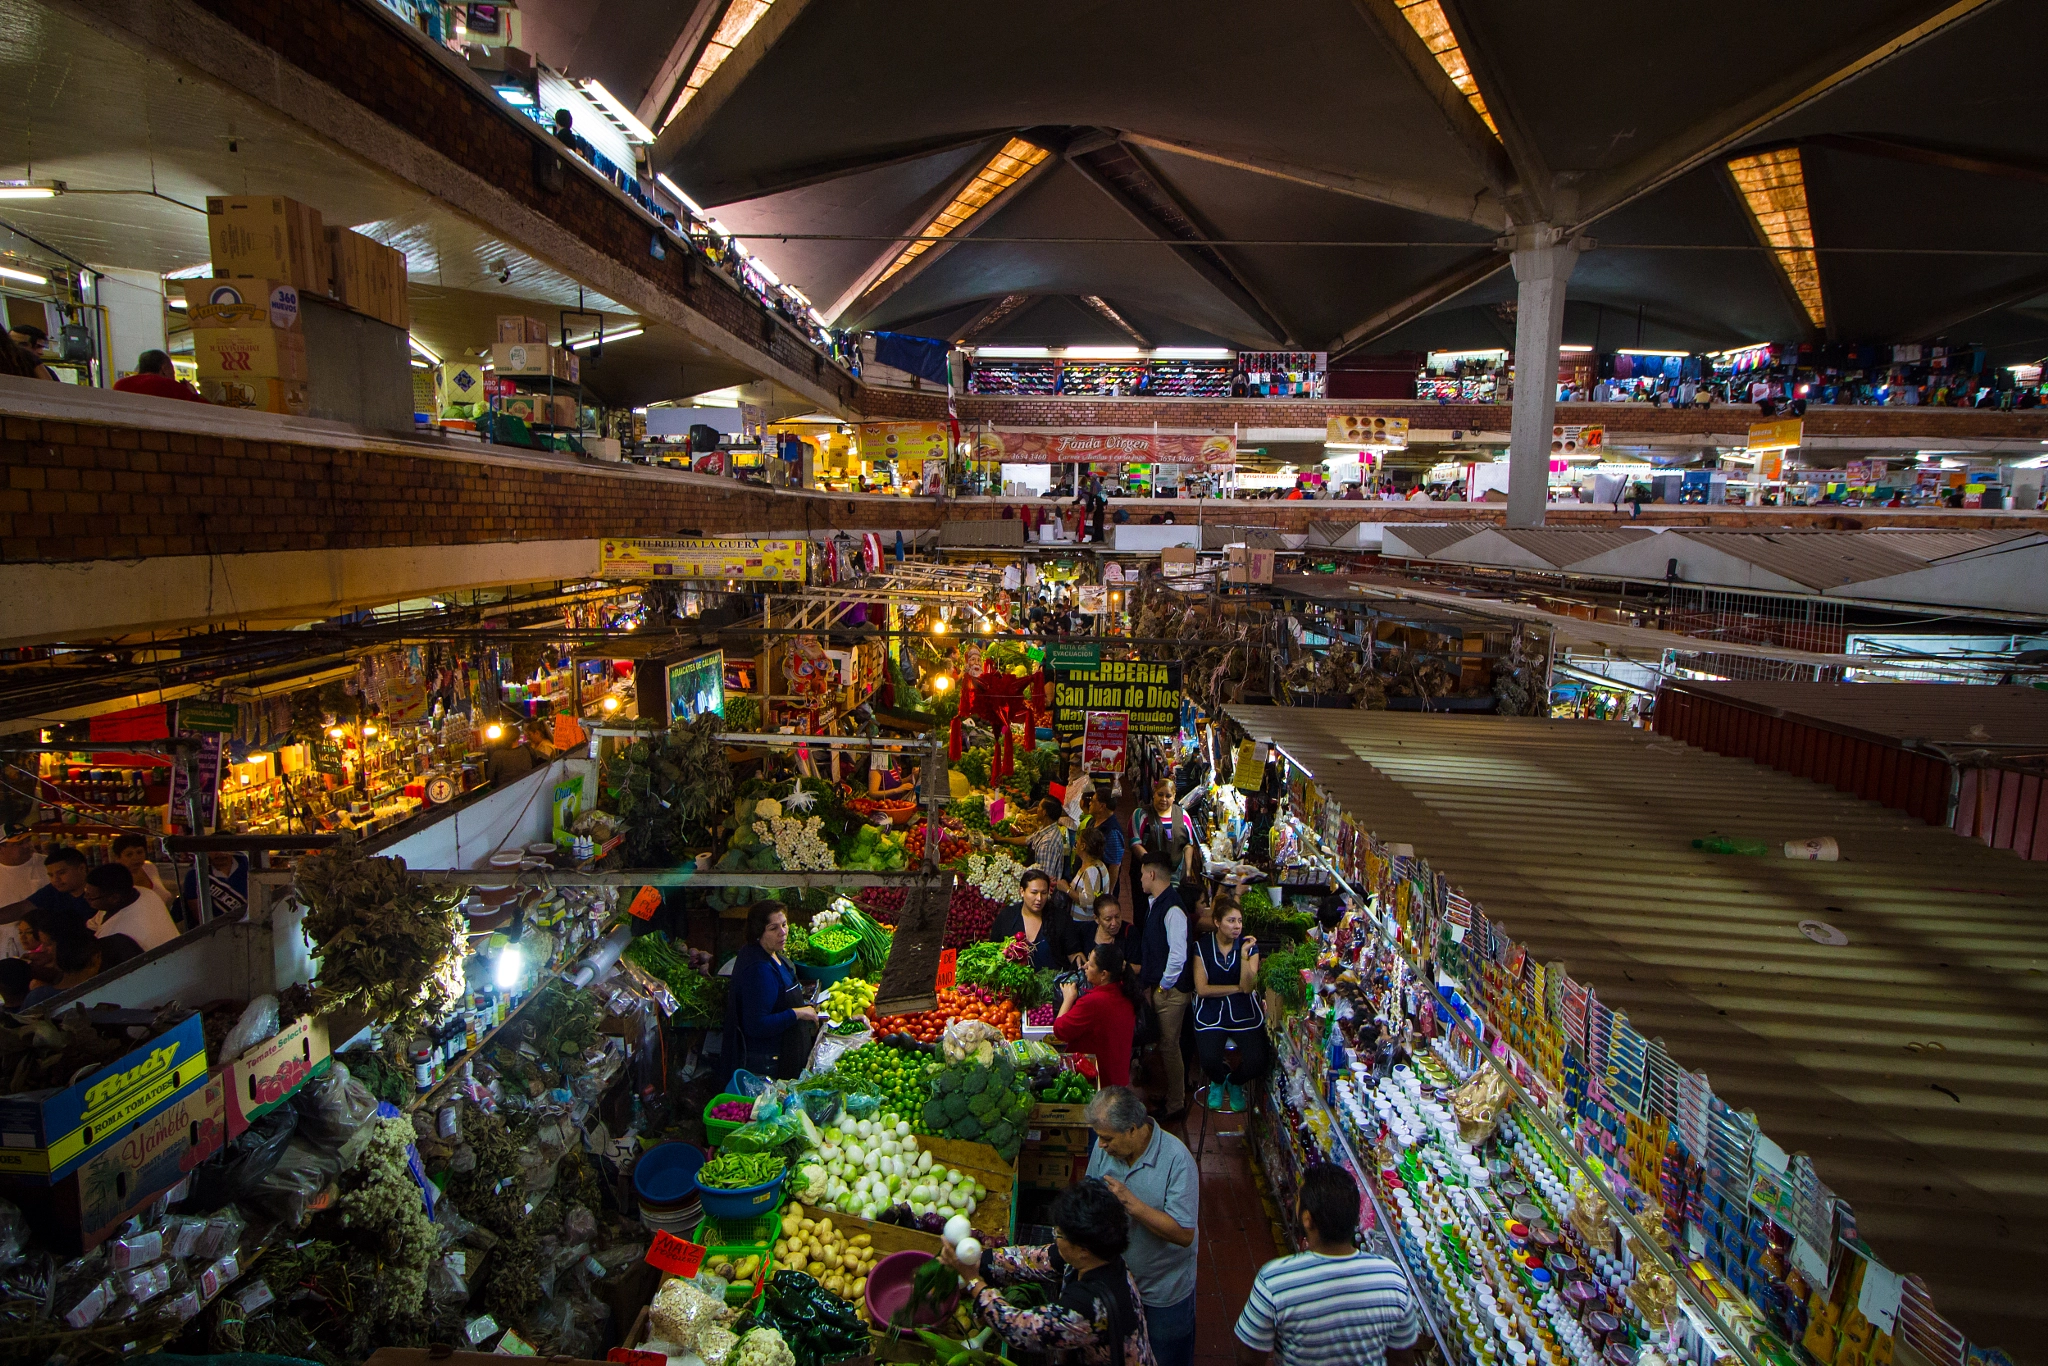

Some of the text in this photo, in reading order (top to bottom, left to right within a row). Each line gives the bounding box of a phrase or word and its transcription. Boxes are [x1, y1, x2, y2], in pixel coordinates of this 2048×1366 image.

[271, 301, 296, 313] HUEVOS
[278, 291, 296, 304] 360
[1056, 436, 1149, 453] Fonda Virgen
[1011, 452, 1031, 460] 3654
[633, 540, 697, 548] HIERBERIA
[701, 540, 715, 548] LA
[1056, 683, 1083, 706] San
[1125, 685, 1144, 708] de
[1147, 686, 1179, 709] Dios
[246, 1027, 303, 1070] Tomate Select
[82, 1041, 180, 1114] Rudy
[94, 1080, 174, 1134] ROMA TOMATOES
[658, 1236, 698, 1257] MAIZ
